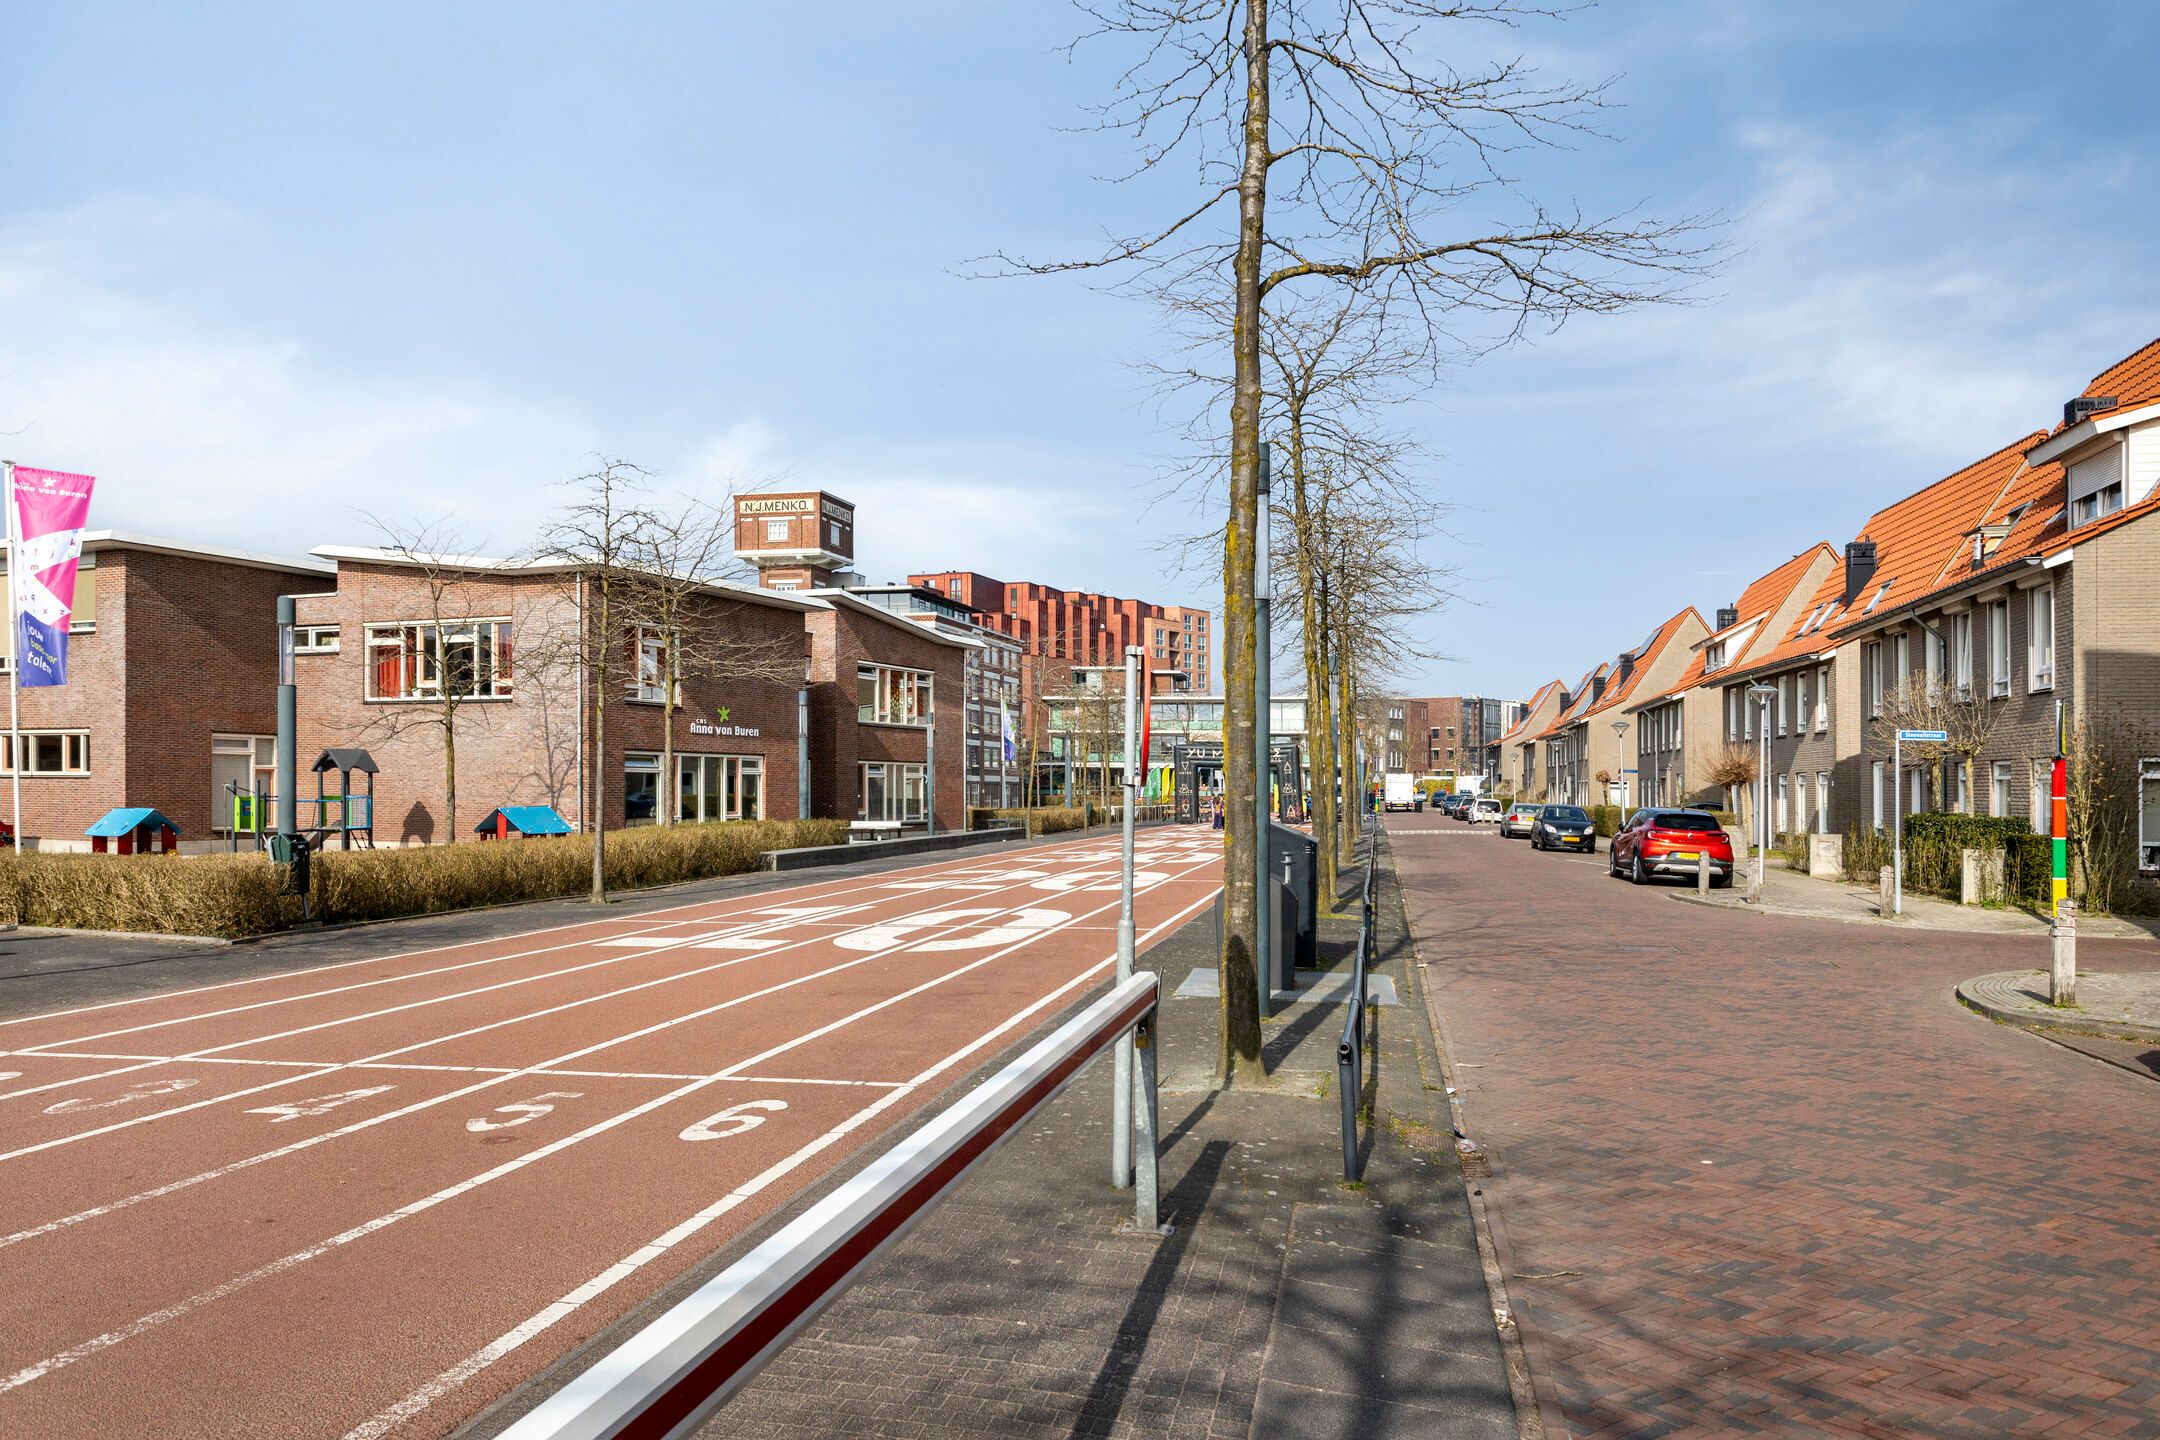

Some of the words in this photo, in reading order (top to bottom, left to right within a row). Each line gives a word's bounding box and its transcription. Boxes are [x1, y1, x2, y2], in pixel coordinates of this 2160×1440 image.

[38, 487, 57, 495] van
[59, 489, 87, 498] Buren
[690, 722, 713, 734] Anna
[715, 725, 732, 735] van
[734, 725, 759, 736] Buren
[878, 870, 1172, 891] 20
[591, 905, 1073, 952] 10
[466, 1092, 584, 1132] 5
[678, 1100, 789, 1141] 6
